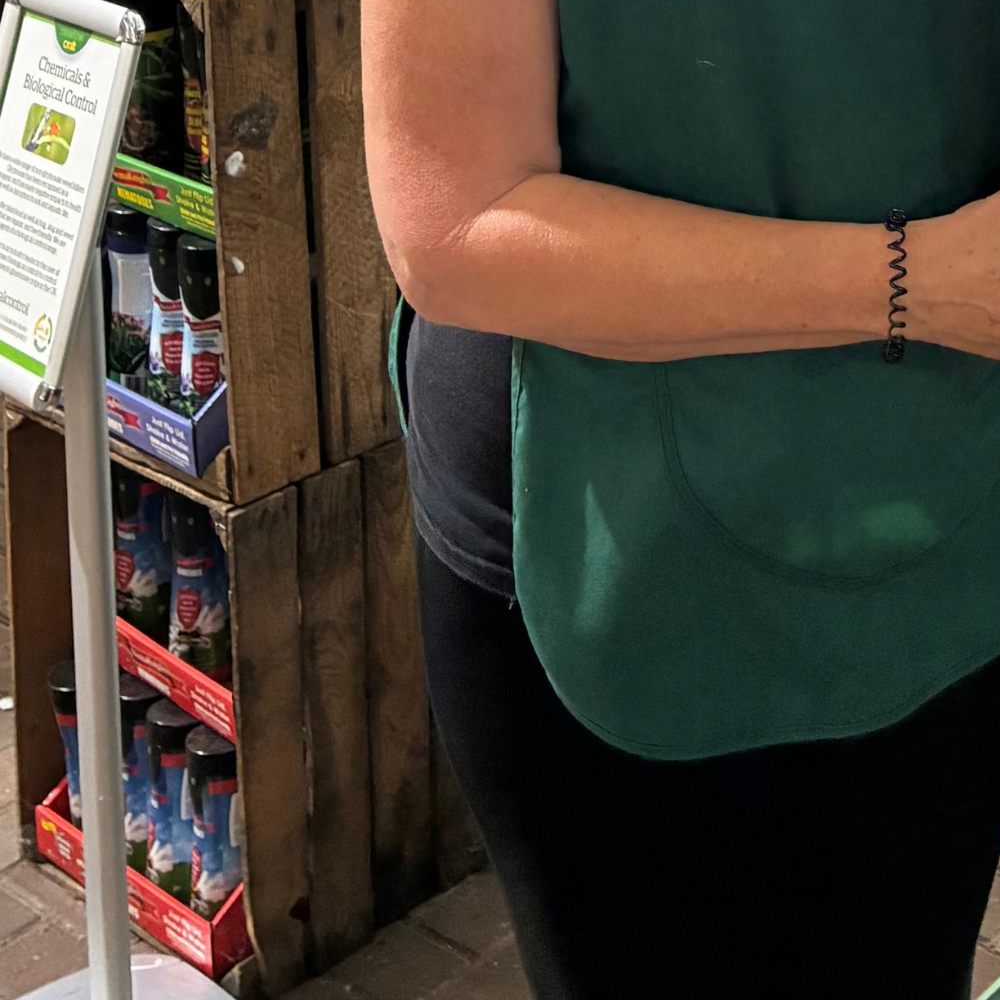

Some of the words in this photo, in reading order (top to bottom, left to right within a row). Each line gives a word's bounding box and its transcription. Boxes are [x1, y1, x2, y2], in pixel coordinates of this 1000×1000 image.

[38, 55, 82, 86] Chemicals
[23, 72, 64, 103] Biological
[64, 89, 98, 116] Control
